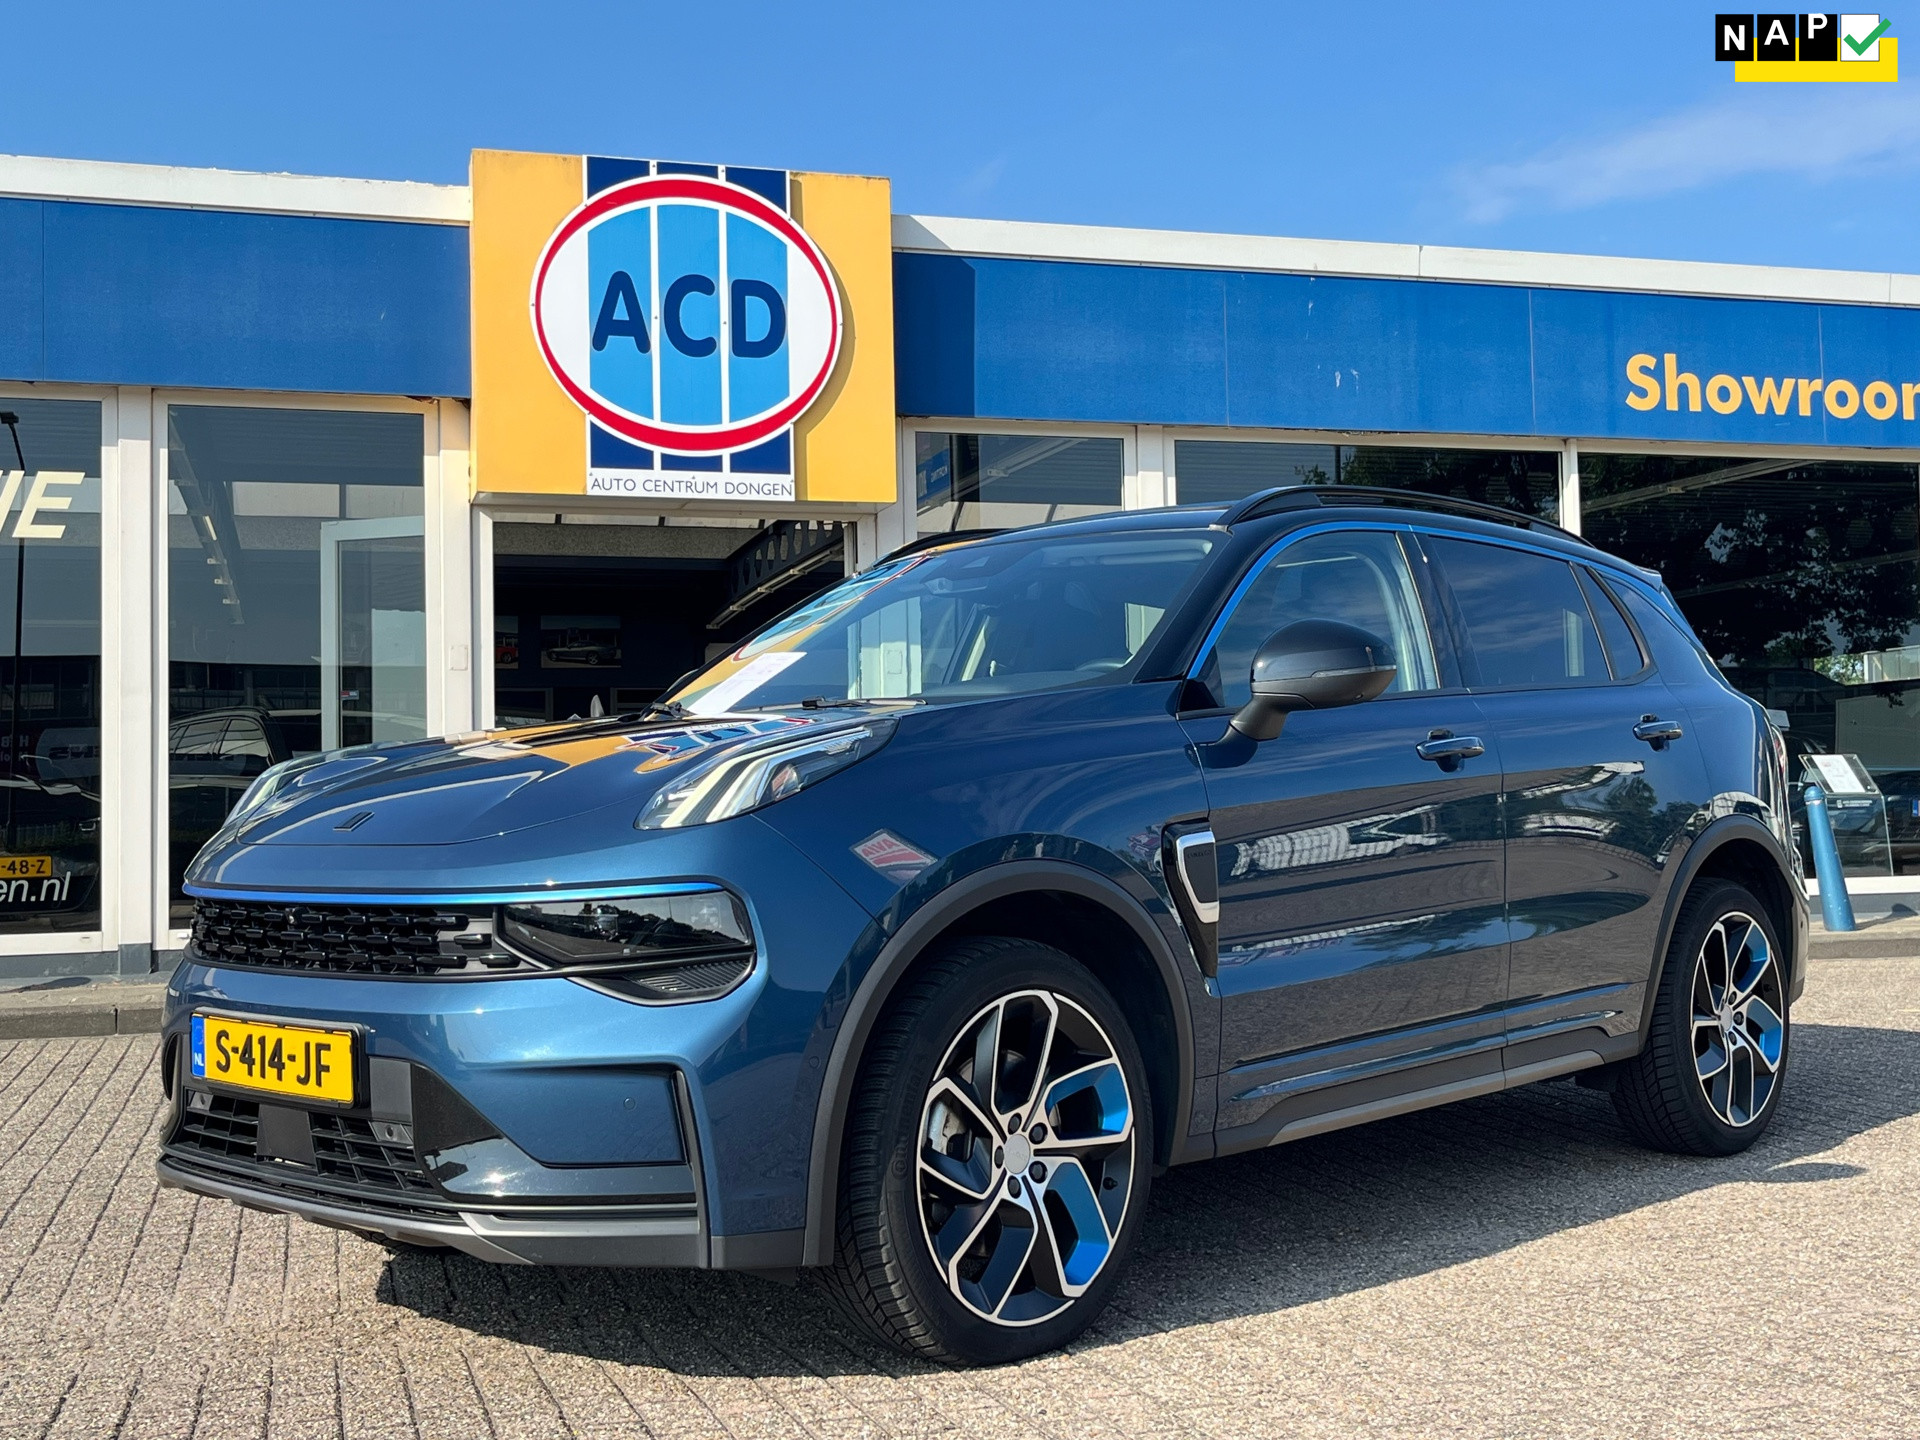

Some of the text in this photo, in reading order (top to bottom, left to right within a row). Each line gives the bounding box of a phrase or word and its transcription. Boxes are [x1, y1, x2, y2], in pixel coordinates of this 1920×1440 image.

[592, 270, 787, 359] ACD
[1625, 353, 1920, 421] Showroo
[0, 470, 86, 539] IE
[591, 478, 793, 496] AUTO CENTRUM DONGEN
[194, 1029, 332, 1088] NL S-414-JF
